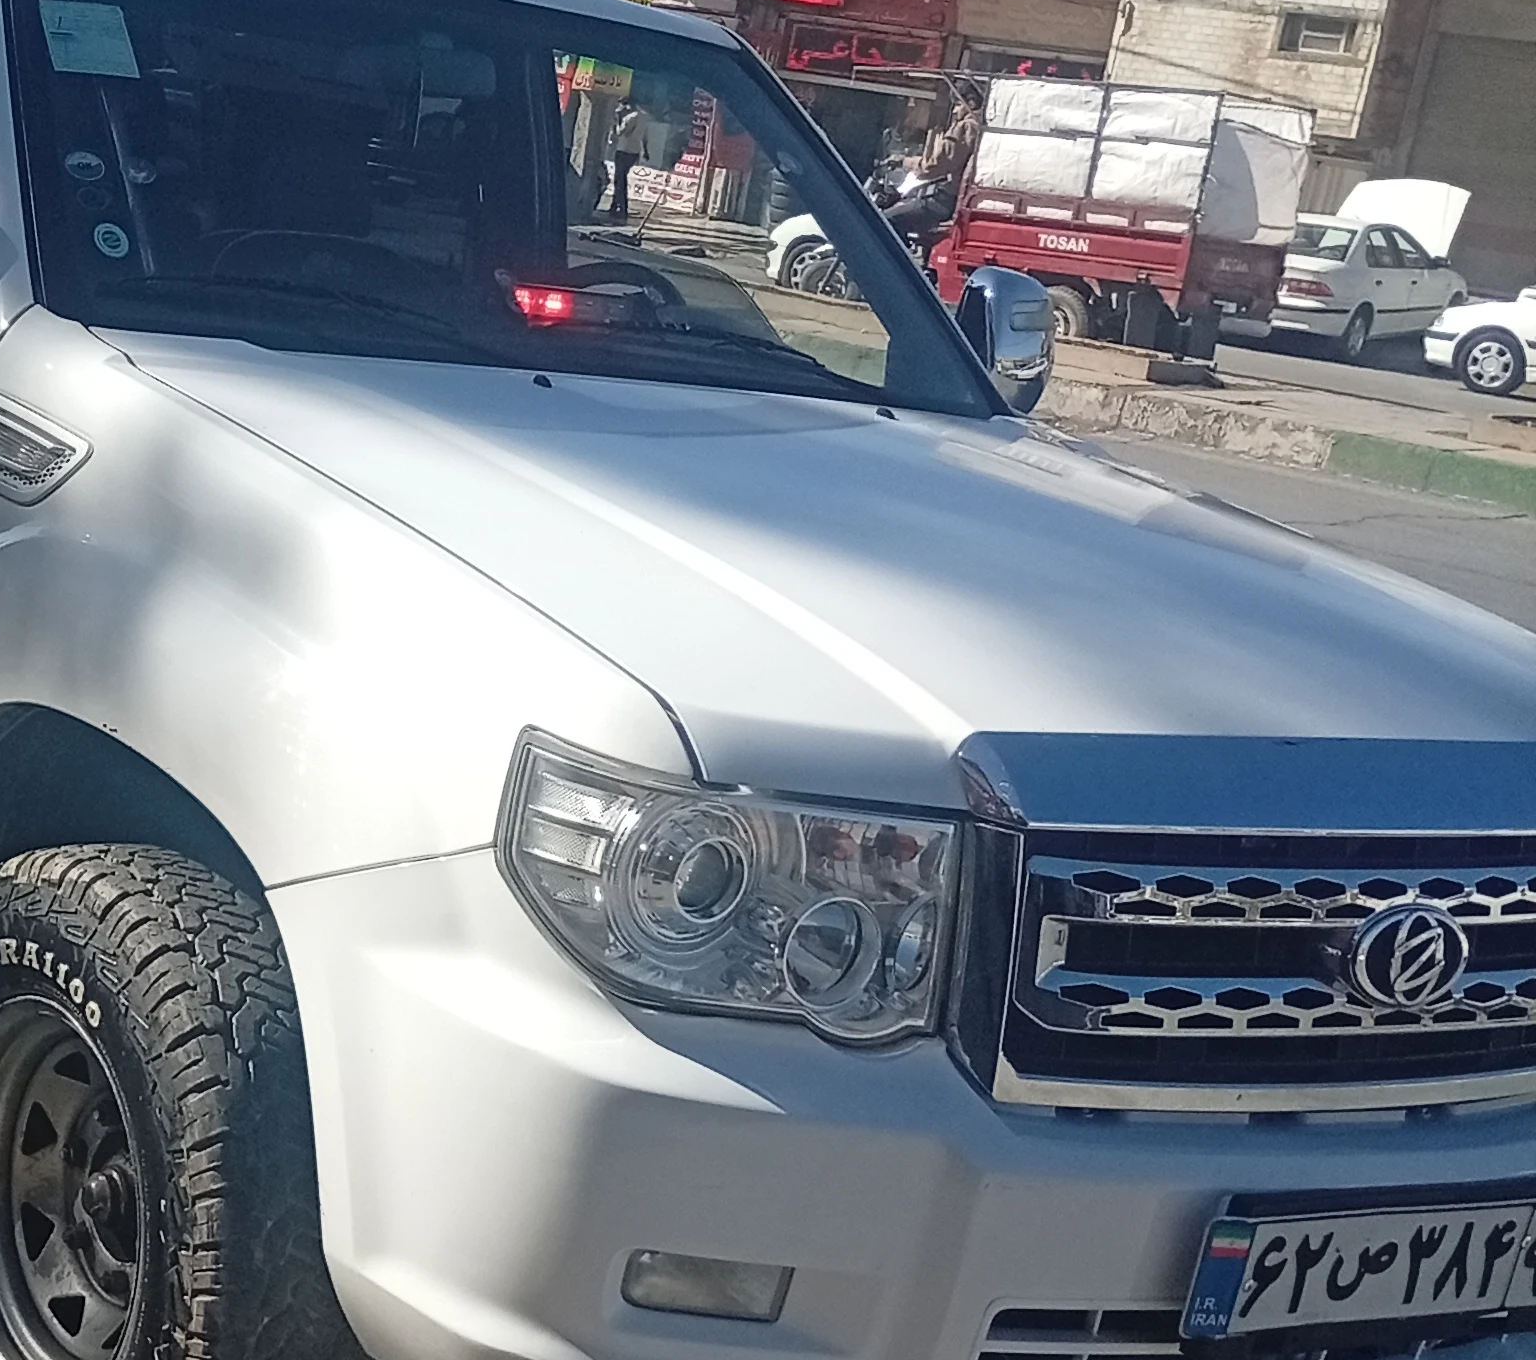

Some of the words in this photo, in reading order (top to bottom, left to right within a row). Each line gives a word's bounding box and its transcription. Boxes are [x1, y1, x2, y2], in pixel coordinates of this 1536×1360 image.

[1037, 232, 1089, 253] TOSAN
[1194, 1296, 1218, 1311] I.R.
[1189, 1313, 1229, 1328] IRAN
